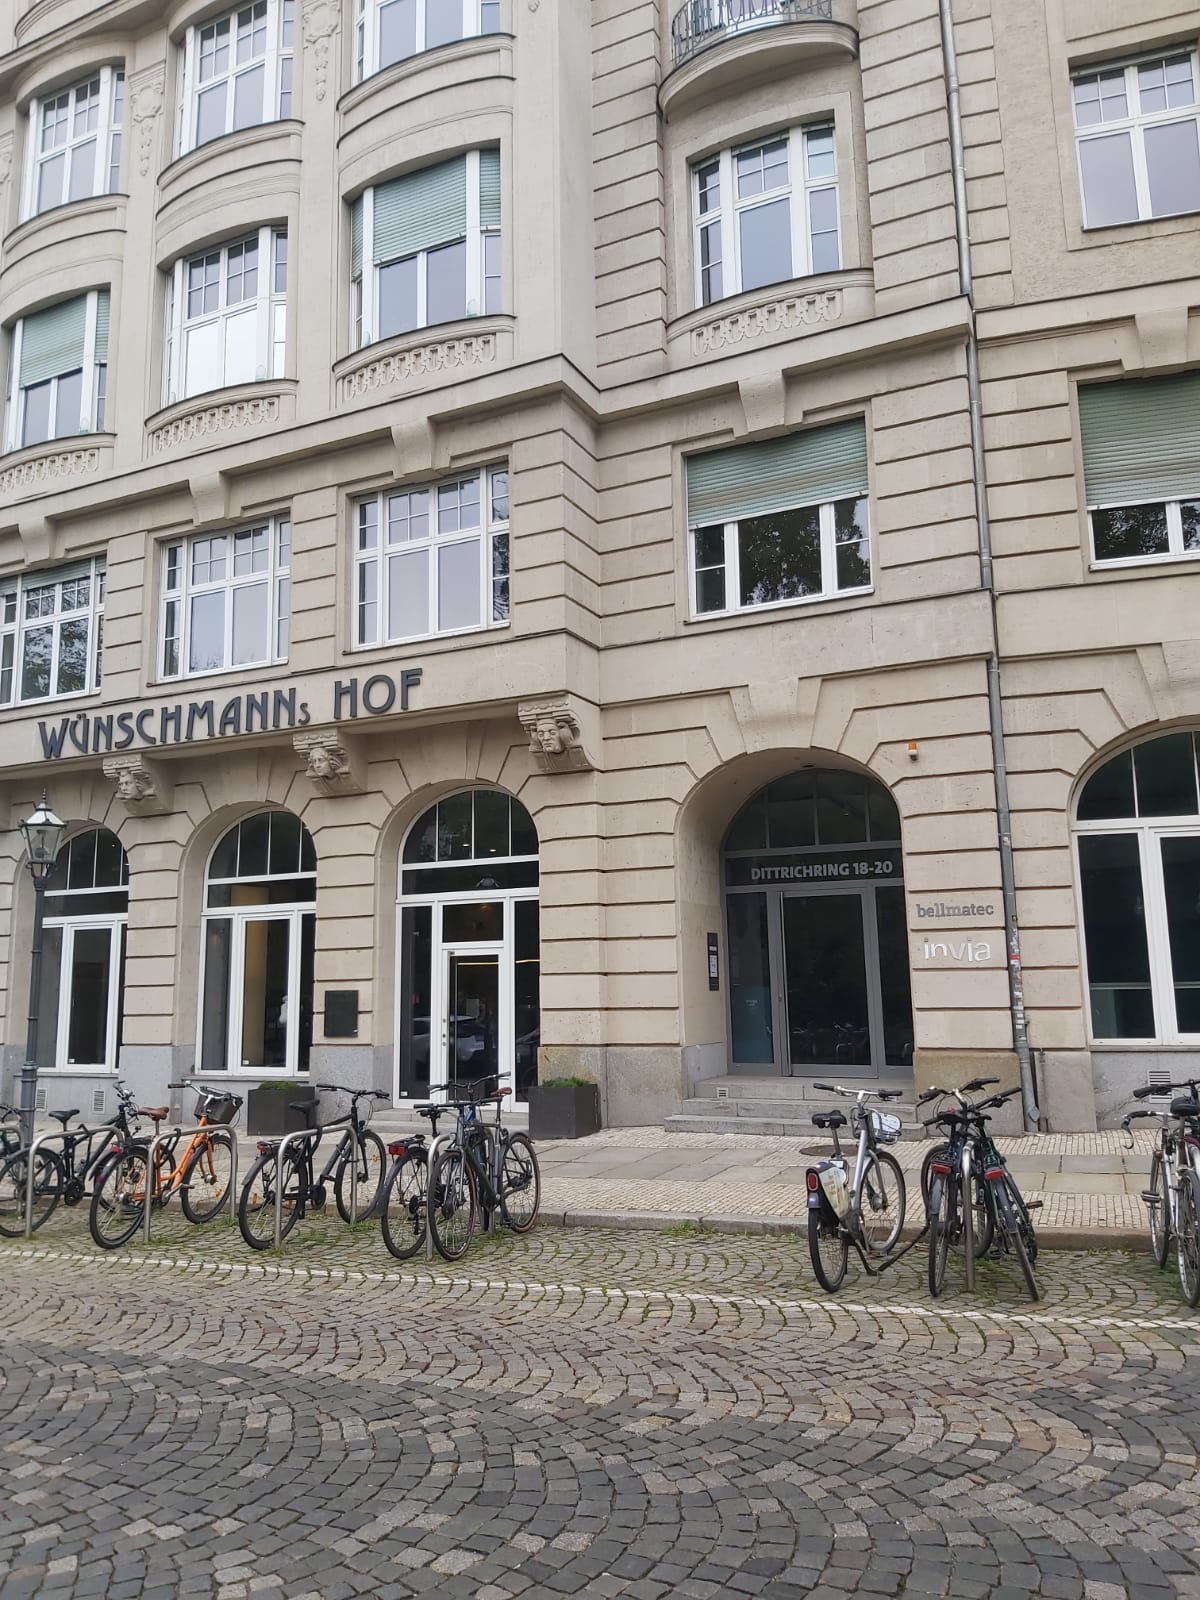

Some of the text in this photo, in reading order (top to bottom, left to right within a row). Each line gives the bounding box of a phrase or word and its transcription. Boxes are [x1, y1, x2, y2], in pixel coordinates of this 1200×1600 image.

[334, 667, 423, 720] HOF
[751, 860, 893, 880] DITTRICHRING 18-20
[916, 902, 994, 918] bellmatec
[923, 937, 992, 962] invia
